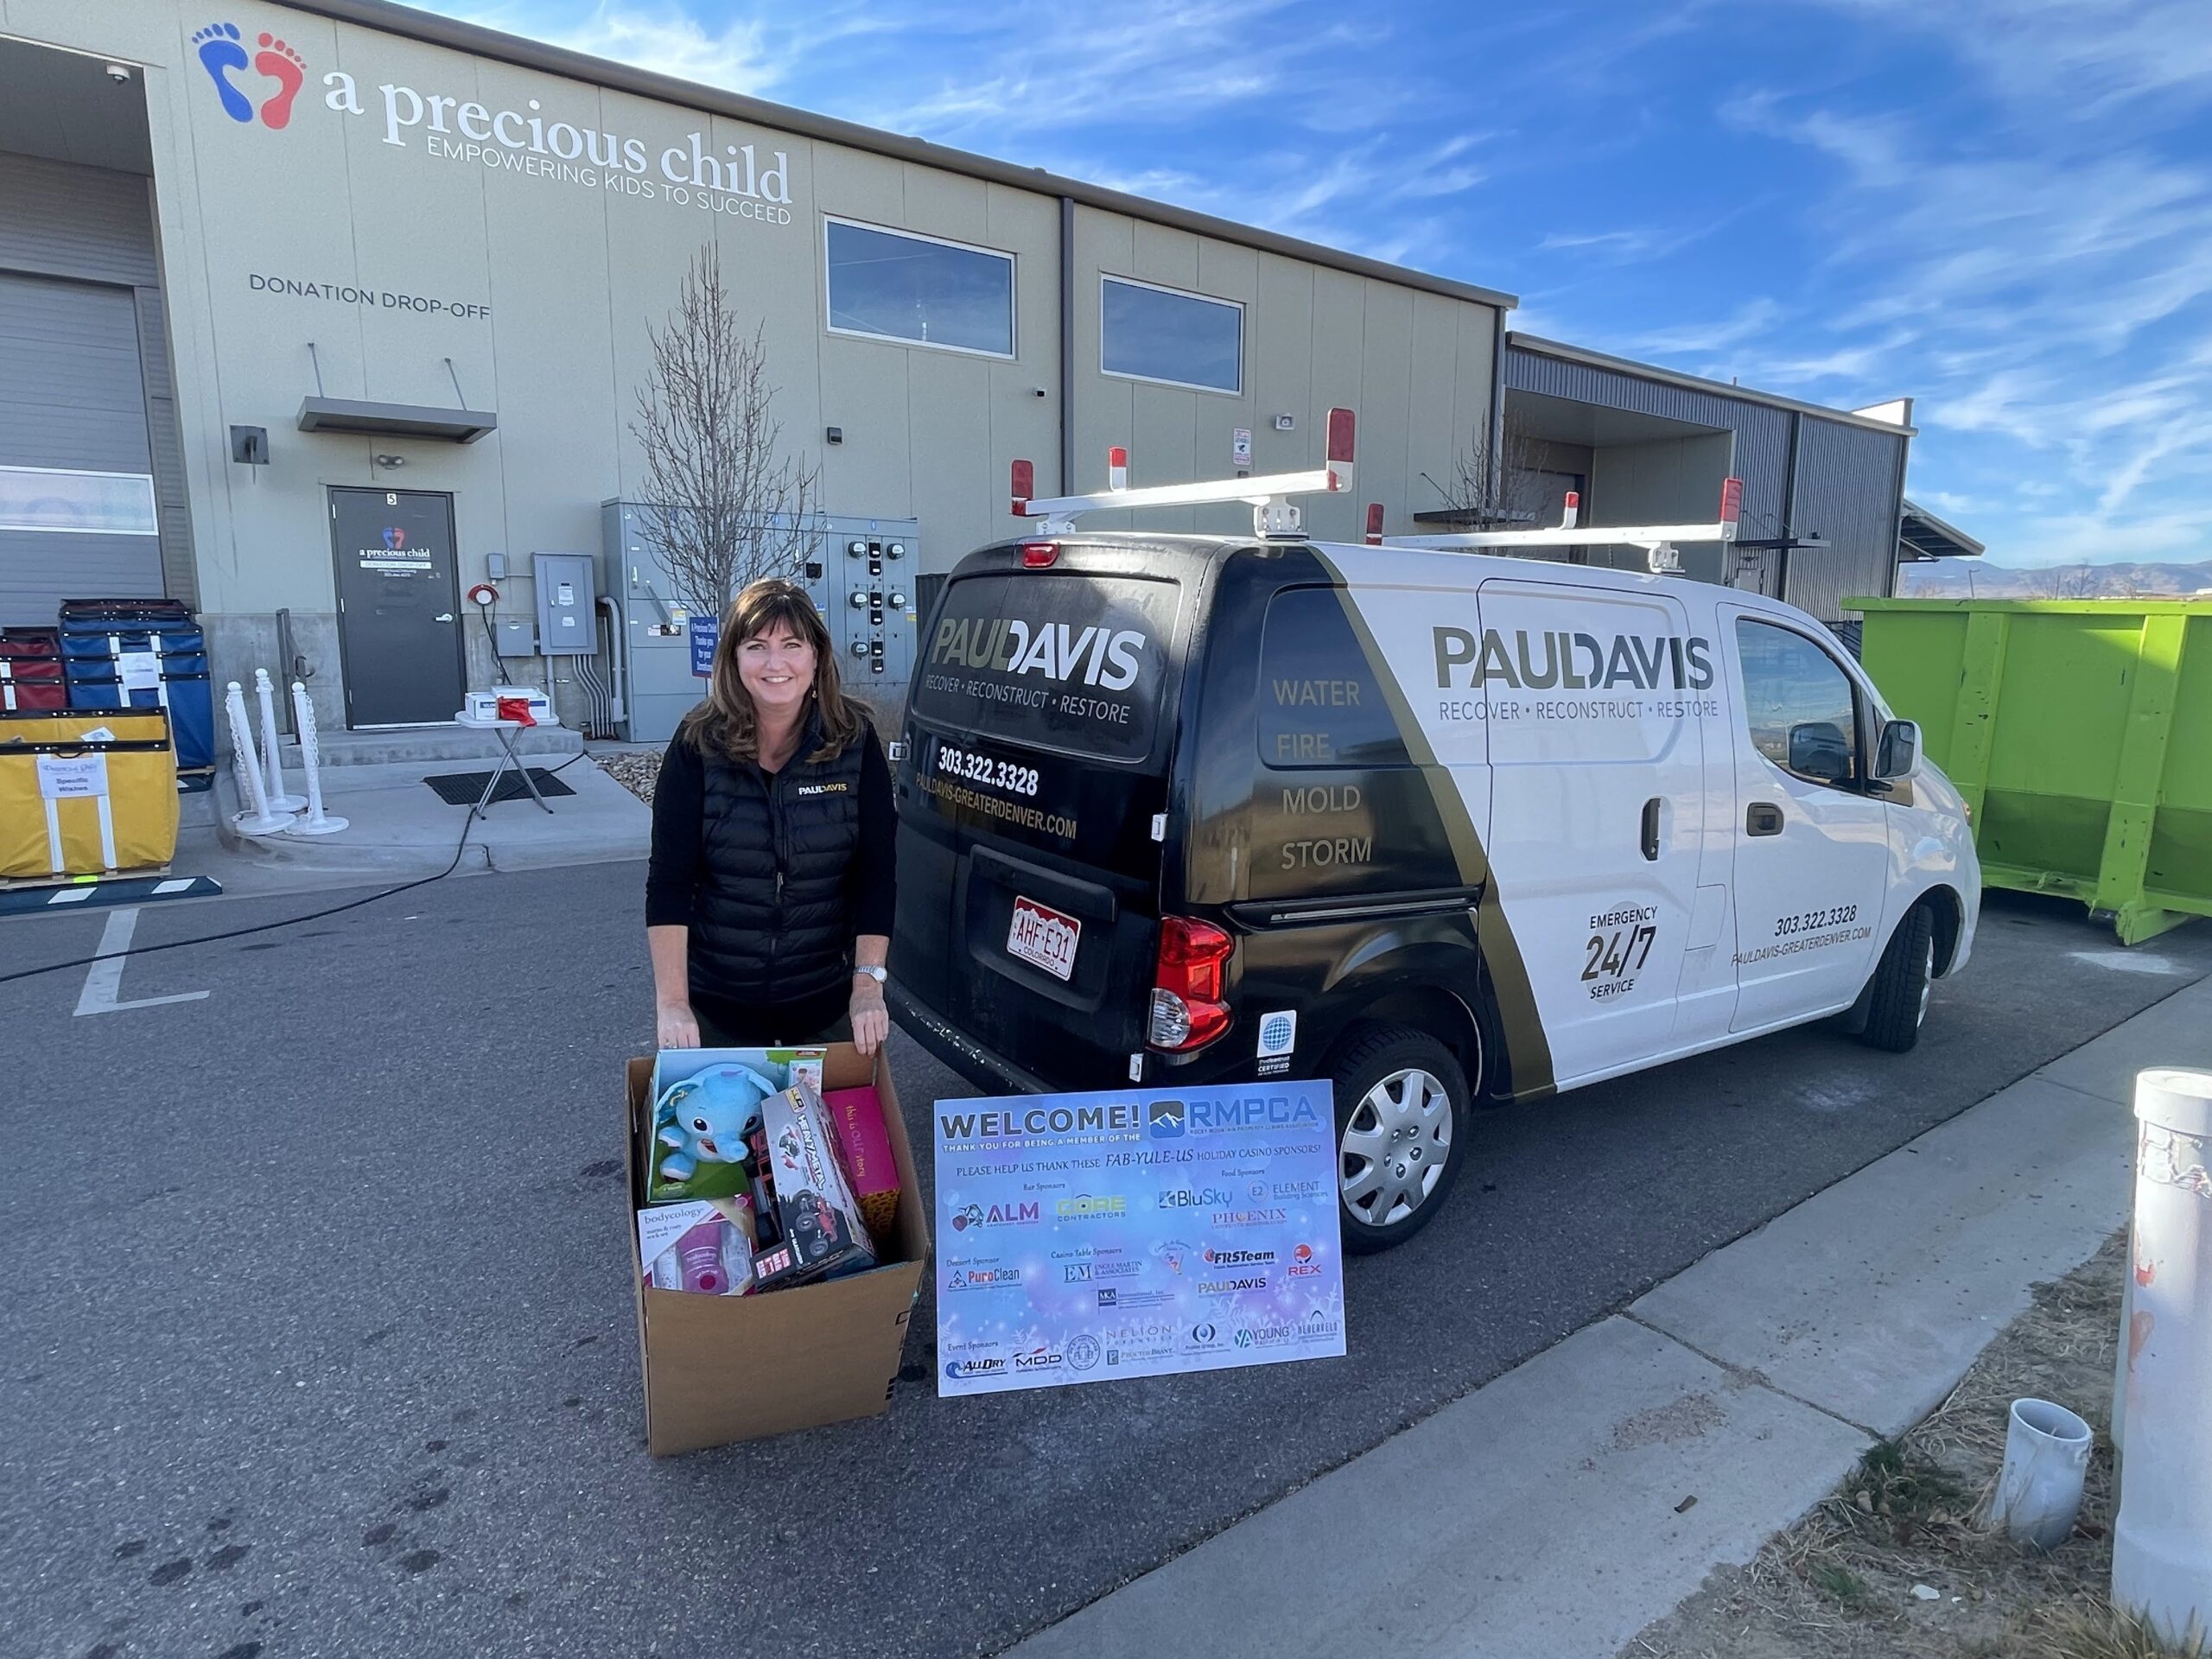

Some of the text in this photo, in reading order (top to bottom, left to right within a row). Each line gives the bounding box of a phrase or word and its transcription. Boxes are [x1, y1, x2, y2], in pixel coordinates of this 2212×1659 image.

[323, 72, 792, 204] a precious child
[427, 136, 791, 226] EMPOWERING KIDS TO SUCCEED
[250, 274, 490, 320] DONATION DROP-OFF
[366, 548, 406, 558] precious
[407, 548, 430, 557] child
[925, 674, 1130, 724] RECOVER RECONSTRUCT RESTORE
[1273, 679, 1361, 706] WATER
[1440, 701, 1719, 720] RECOVER RECONSTRUCT RESTORE
[1277, 734, 1331, 760] FIRE
[938, 747, 1039, 796] 303.322.3328
[916, 772, 1076, 839] PAULDAVIS-GREATERDENVER.COM
[1283, 785, 1361, 815] MOLD
[1281, 836, 1372, 870] STORM
[1590, 906, 1657, 929] EMERGENCY
[1774, 905, 1857, 937] 303.322.3328
[1580, 925, 1656, 982] 24/7
[1731, 926, 1872, 967] PAULDAVIS-GREATERDENVER.COM
[1590, 979, 1634, 999] SERVICE
[941, 1105, 1141, 1139] WELCOME!
[1189, 1096, 1318, 1128] RMPCA
[944, 1144, 976, 1154] THANK
[980, 1142, 999, 1151] YOU
[1025, 1139, 1054, 1147] BEING
[1067, 1135, 1105, 1145] MEMBER
[1123, 1133, 1141, 1141] THE
[957, 1144, 1321, 1177] PLEASE HELP US THANK THESE FAB-YULE-US HOLIDAY CASINO SPONSORS!
[1237, 1168, 1265, 1179] Sponsors
[1036, 1182, 1065, 1192] Sponsors
[1252, 1186, 1263, 1197] E2
[1273, 1181, 1320, 1192] ELEMENT
[1177, 1188, 1232, 1208] BluSky
[645, 1209, 702, 1224] bodycology
[986, 1202, 1039, 1223] ALM
[1058, 1211, 1126, 1223] CONTRACTORS
[946, 1256, 1000, 1267] Dessert Sponsor
[1051, 1248, 1122, 1259] Casino Table Sponsors
[968, 1268, 1020, 1283] PuroClean
[1288, 1264, 1321, 1275] REX
[1253, 1326, 1290, 1339] YOUNG
[968, 1341, 999, 1350] Sponsors
[1015, 1354, 1062, 1367] MDD
